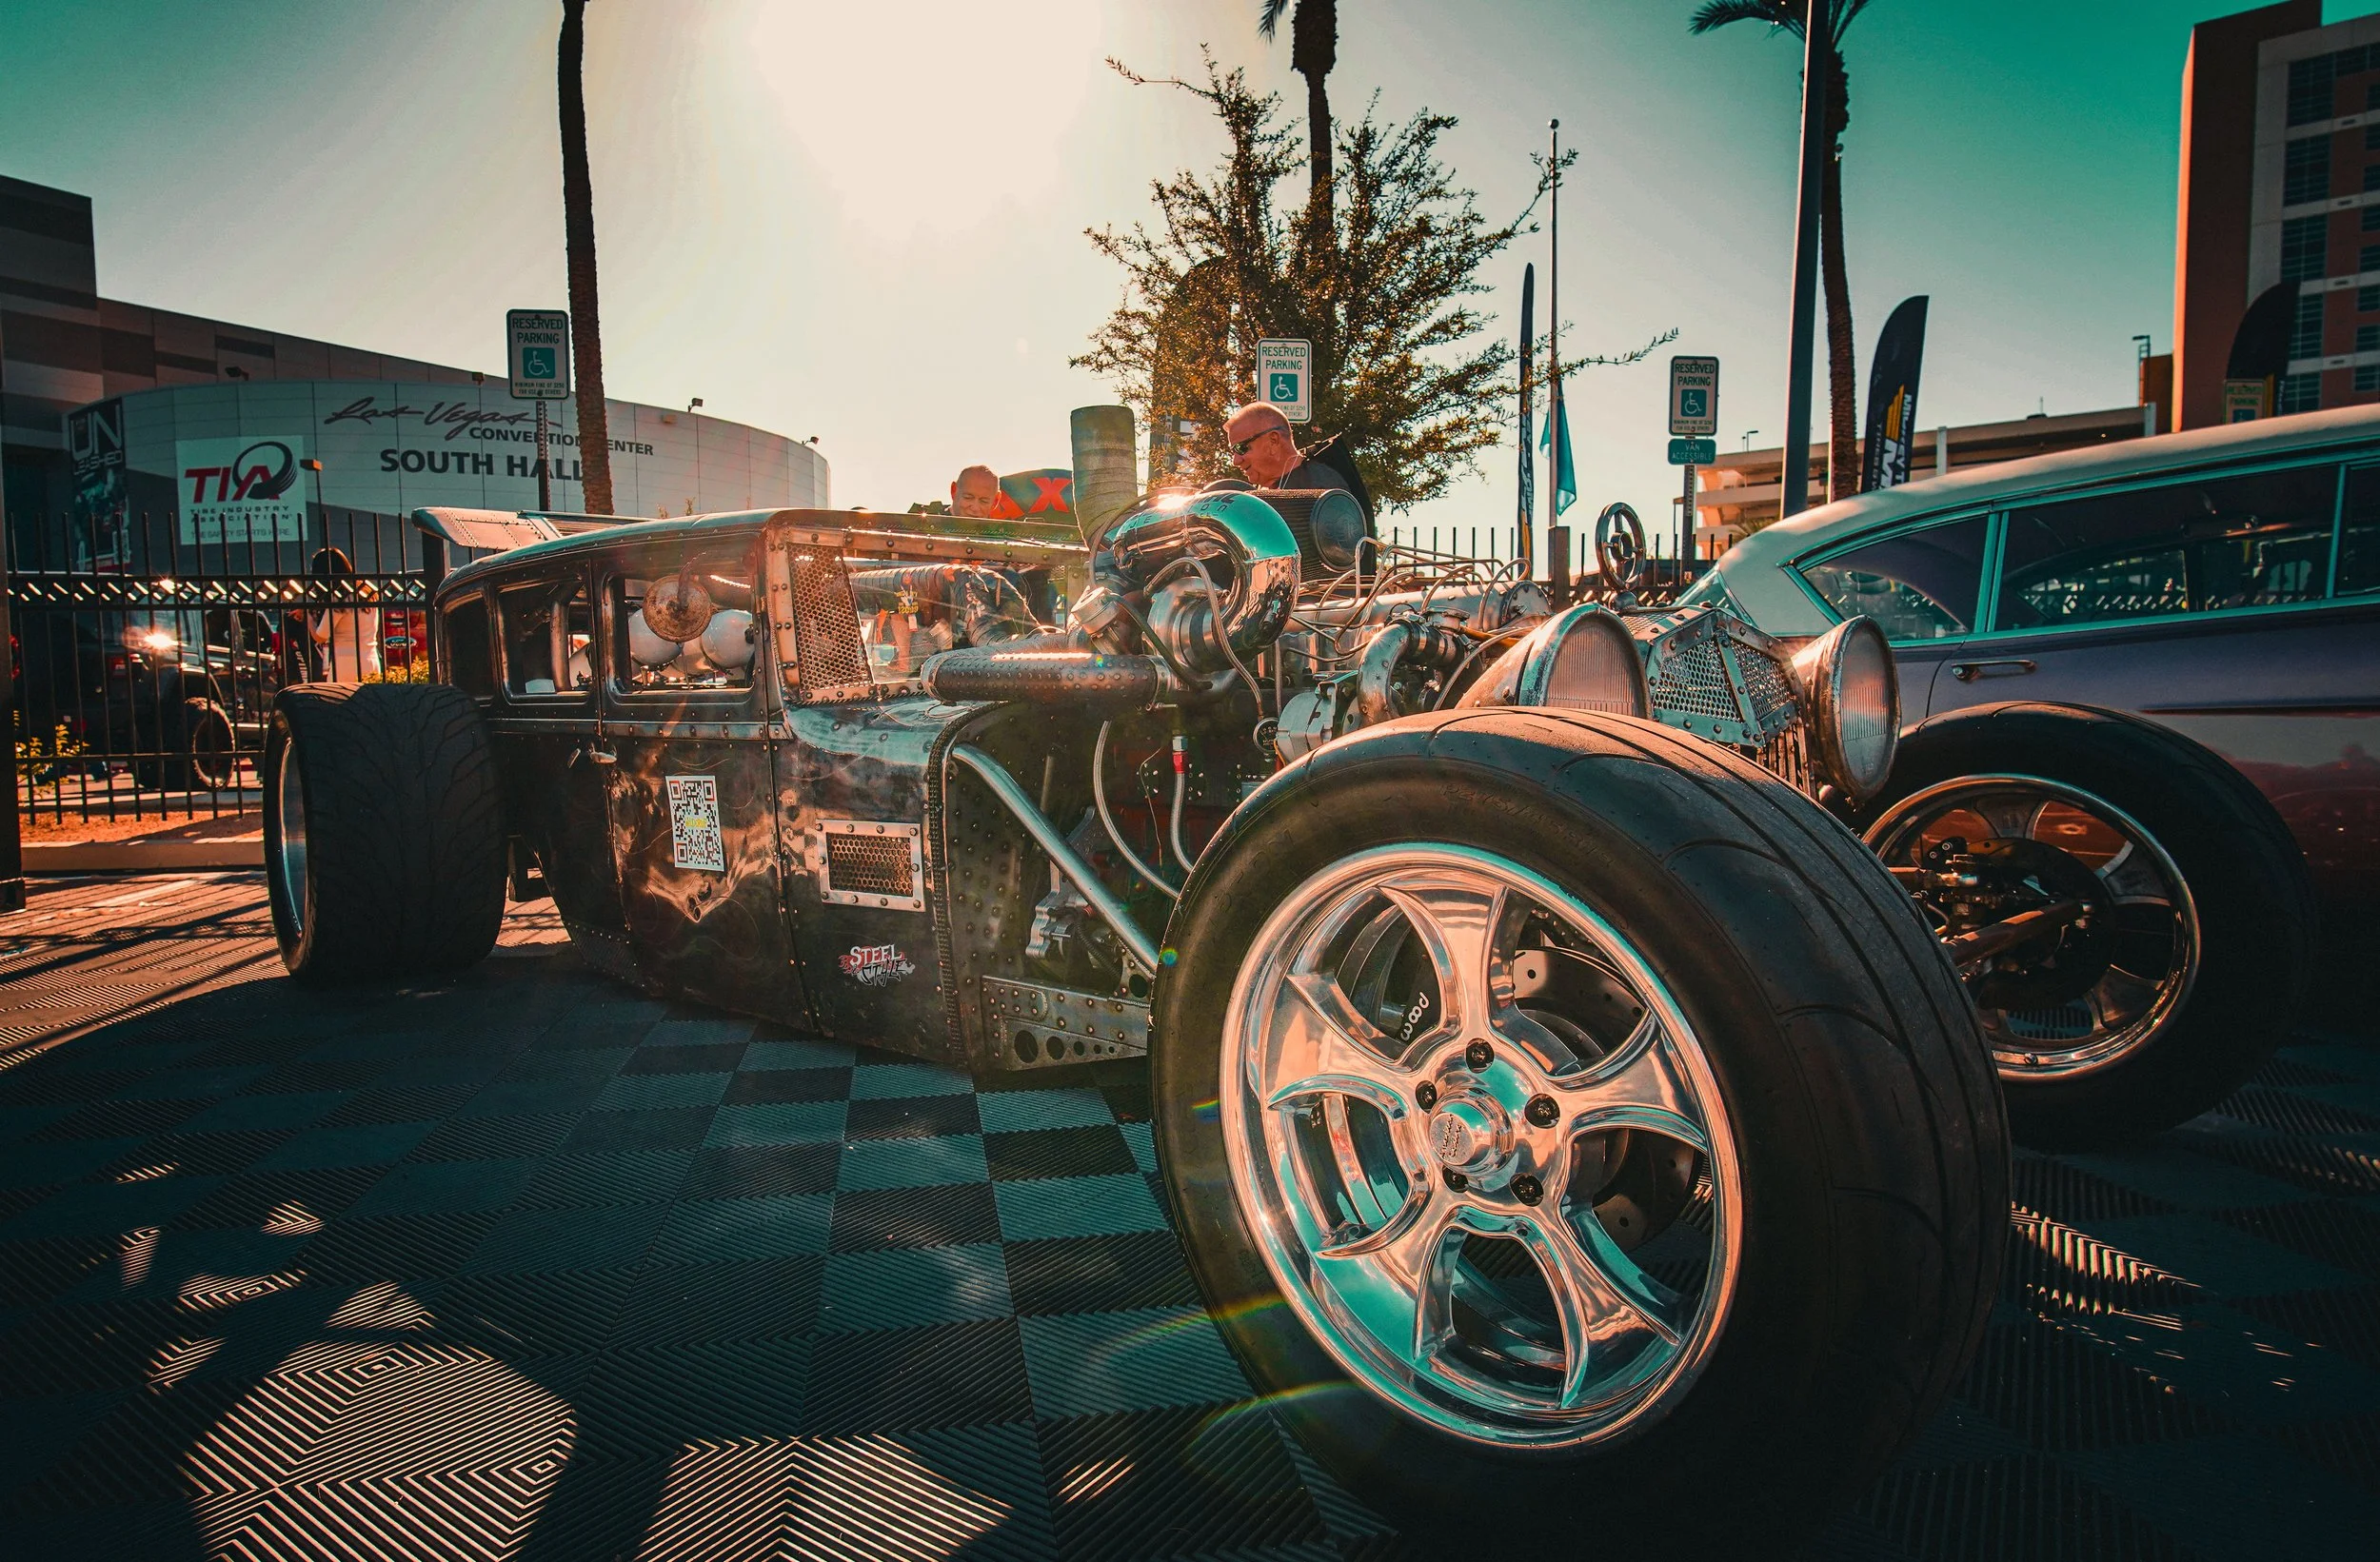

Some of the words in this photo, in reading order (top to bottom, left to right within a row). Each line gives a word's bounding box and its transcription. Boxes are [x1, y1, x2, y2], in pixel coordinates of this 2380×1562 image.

[512, 318, 564, 329] RESERVED
[517, 332, 560, 344] PARKING
[1261, 346, 1306, 357] RESERVED
[1265, 359, 1302, 370] PARKING
[1675, 364, 1715, 374] RESERVED
[1677, 376, 1712, 386] PARKING
[325, 396, 425, 426] Las
[425, 401, 563, 441] Vegas
[70, 404, 123, 461] UN
[606, 438, 654, 456] ENTER
[1685, 443, 1700, 451] VAN
[1672, 451, 1713, 461] ACCESSIBLE
[381, 448, 494, 476] SOUTH
[184, 464, 281, 504] TIA
[222, 504, 289, 514] INDUSTRY
[190, 514, 289, 523] ASSCITIN
[849, 944, 902, 967] STEEL
[862, 959, 908, 987] STYLE
